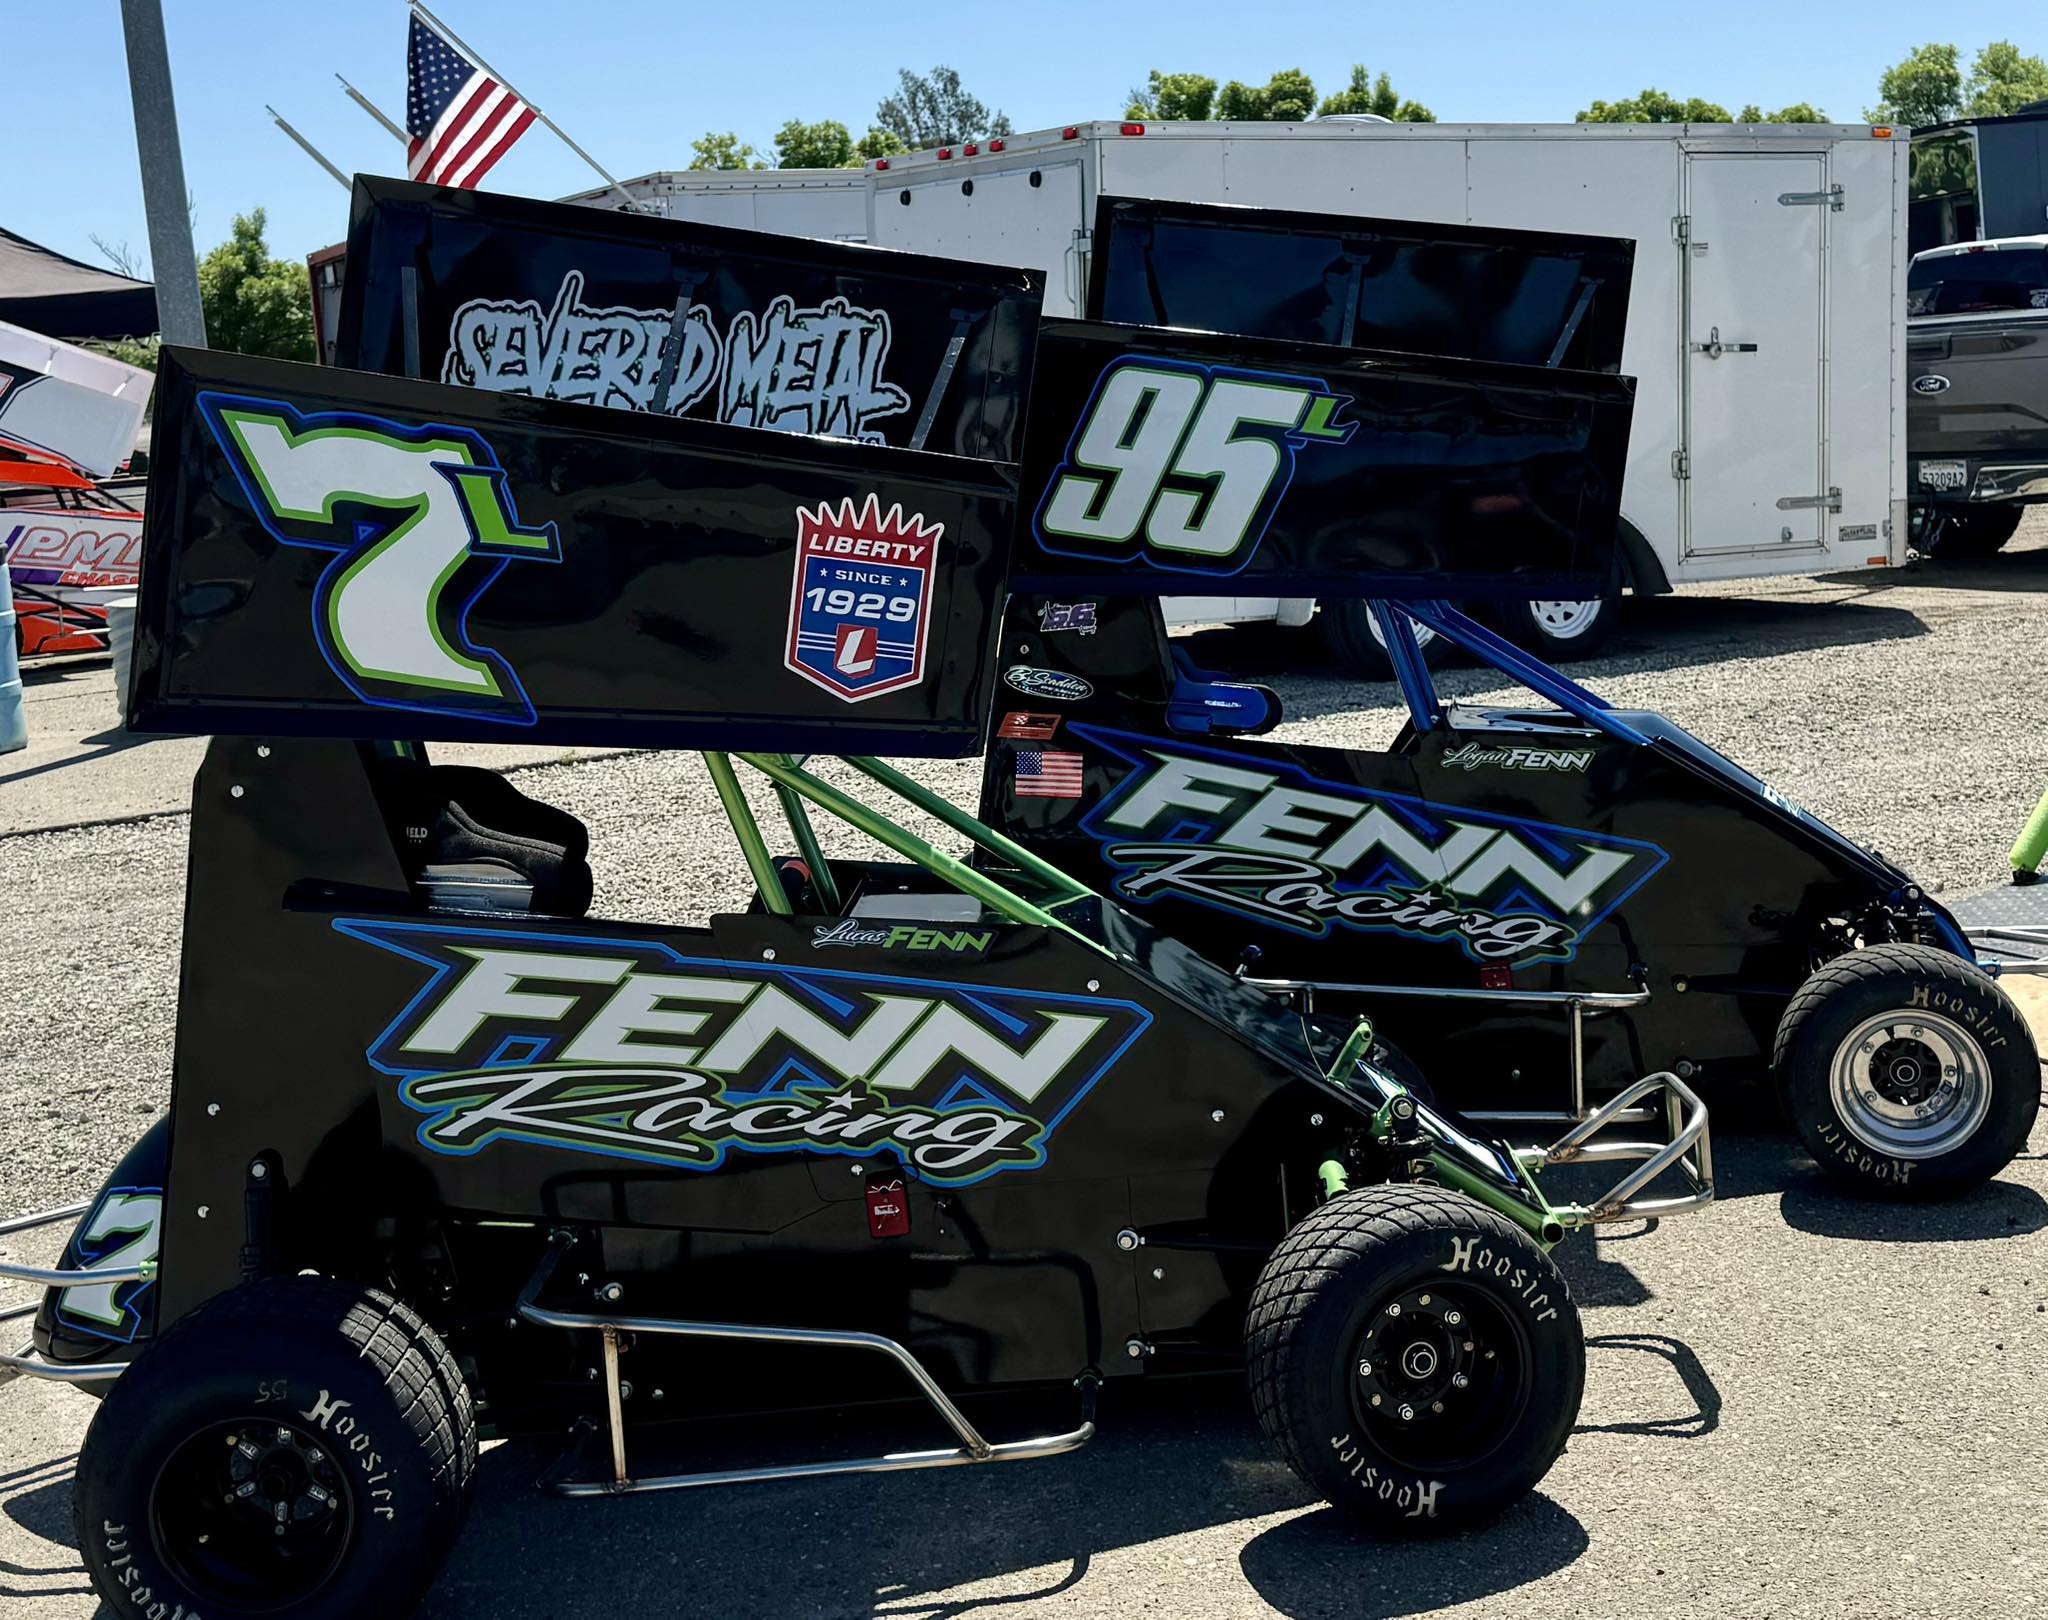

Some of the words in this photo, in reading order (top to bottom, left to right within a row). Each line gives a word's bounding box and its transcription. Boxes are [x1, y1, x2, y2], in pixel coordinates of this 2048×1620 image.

[446, 274, 716, 412] SEVERED
[724, 299, 907, 434] METAL
[809, 533, 926, 562] LIBERTY
[835, 569, 893, 586] SINCE
[806, 587, 917, 622] 1929
[1441, 742, 1510, 770] Logan
[1504, 748, 1591, 769] FENN
[1104, 750, 1635, 915] FENN
[812, 919, 888, 948] Lucas
[881, 925, 993, 952] FENN
[1111, 847, 1571, 957] Racing
[399, 946, 1108, 1104] FENN
[1905, 981, 2008, 1047] Hoosier
[414, 1068, 1038, 1169] Racing
[61, 1193, 163, 1326] 7
[1439, 1235, 1558, 1322] Hoosier
[298, 1389, 396, 1521] Hoosier
[1331, 1433, 1447, 1518] Hoosier
